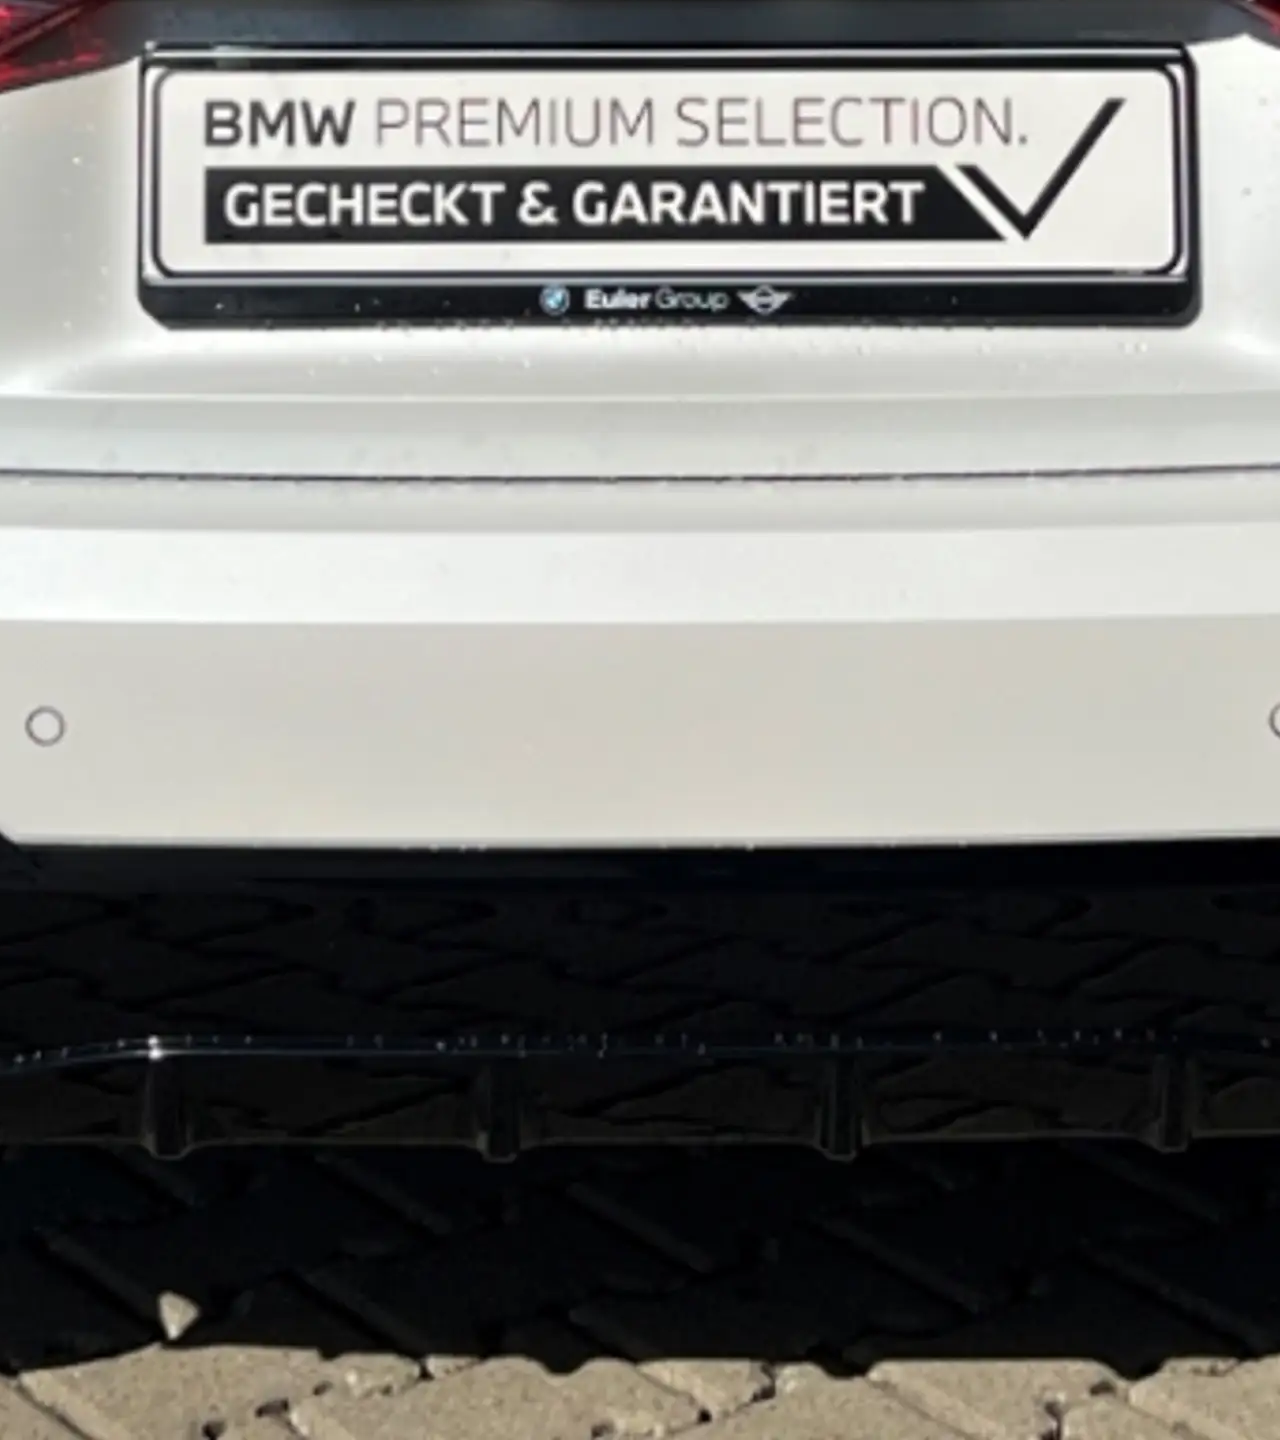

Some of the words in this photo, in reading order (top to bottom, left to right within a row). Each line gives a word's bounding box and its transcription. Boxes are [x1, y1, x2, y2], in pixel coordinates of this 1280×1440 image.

[204, 98, 356, 148] BMW
[375, 97, 654, 148] PREMIUM
[675, 96, 1028, 148] SELECTION.
[223, 180, 506, 227] GECHECKT
[517, 180, 558, 227] &
[571, 180, 926, 227] GARANTIERT
[583, 288, 652, 310] Euler
[654, 287, 730, 312] Group
